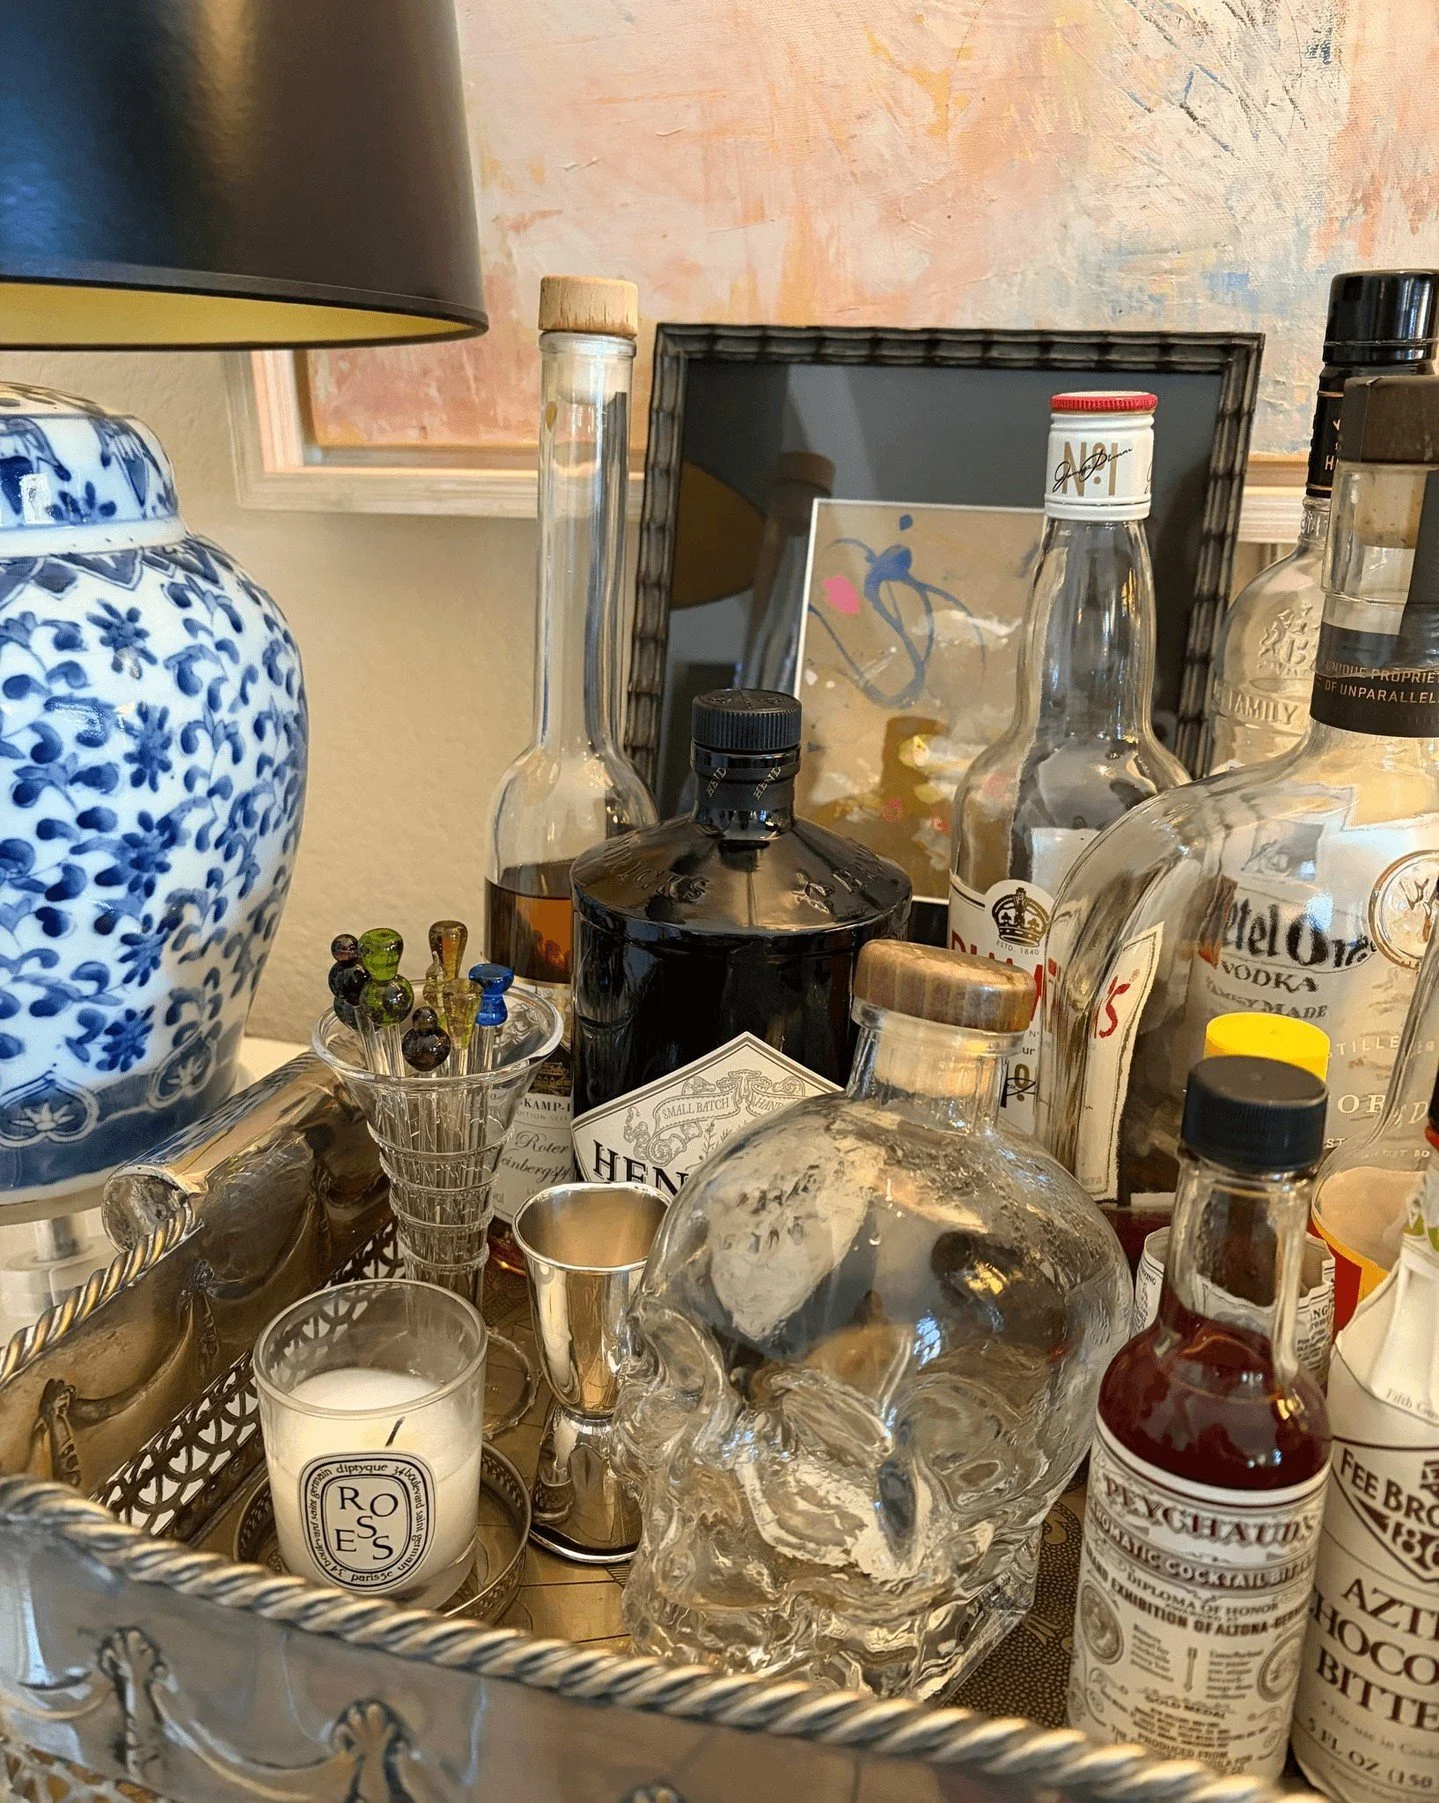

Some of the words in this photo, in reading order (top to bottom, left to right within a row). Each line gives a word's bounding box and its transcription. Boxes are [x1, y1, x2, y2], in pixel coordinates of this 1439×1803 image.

[1339, 684, 1439, 704] UNPARALLEL
[1221, 961, 1319, 993] VODKA
[662, 1102, 694, 1120] SMALL
[695, 1096, 730, 1113] BATCH
[515, 1131, 570, 1154] Roter
[592, 1139, 690, 1197] HEN
[1340, 1447, 1379, 1500] FEE
[1383, 1478, 1439, 1529] BRO
[1165, 1559, 1267, 1590] COCKTAIL
[1310, 1592, 1439, 1687] HOCO
[1316, 1644, 1439, 1734] BITTE
[1347, 1750, 1380, 1776] OZ
